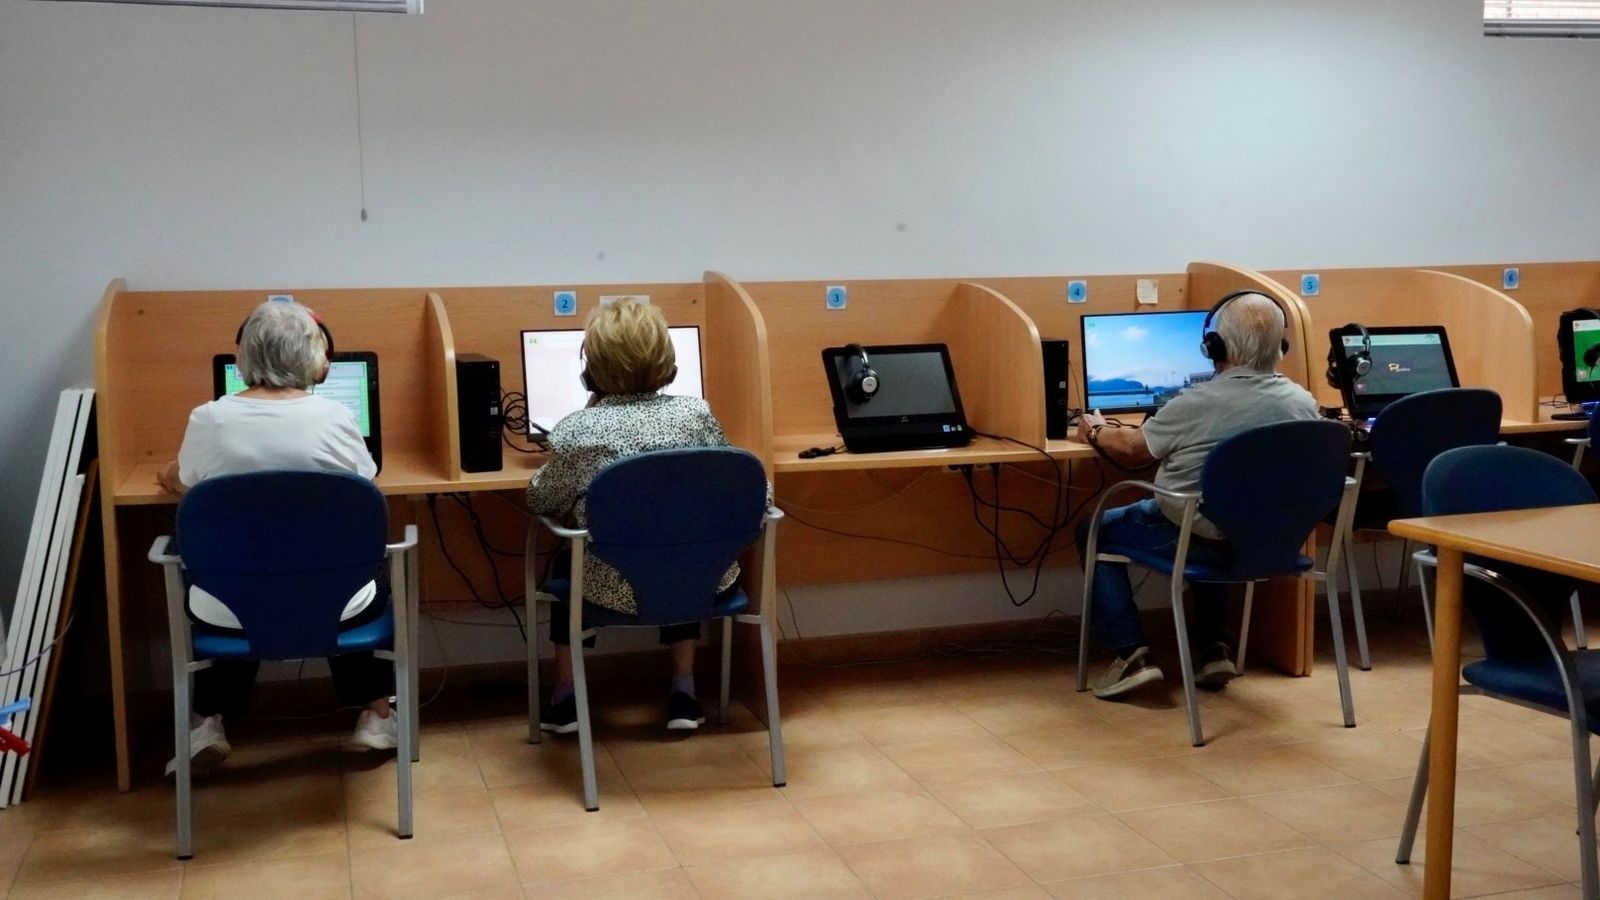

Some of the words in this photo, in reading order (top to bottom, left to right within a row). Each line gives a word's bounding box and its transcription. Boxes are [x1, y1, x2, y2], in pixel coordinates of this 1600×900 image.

[1508, 273, 1514, 282] 6
[1307, 281, 1313, 290] 5
[1074, 288, 1080, 297] 4
[833, 293, 839, 303] 3
[561, 299, 568, 309] 2
